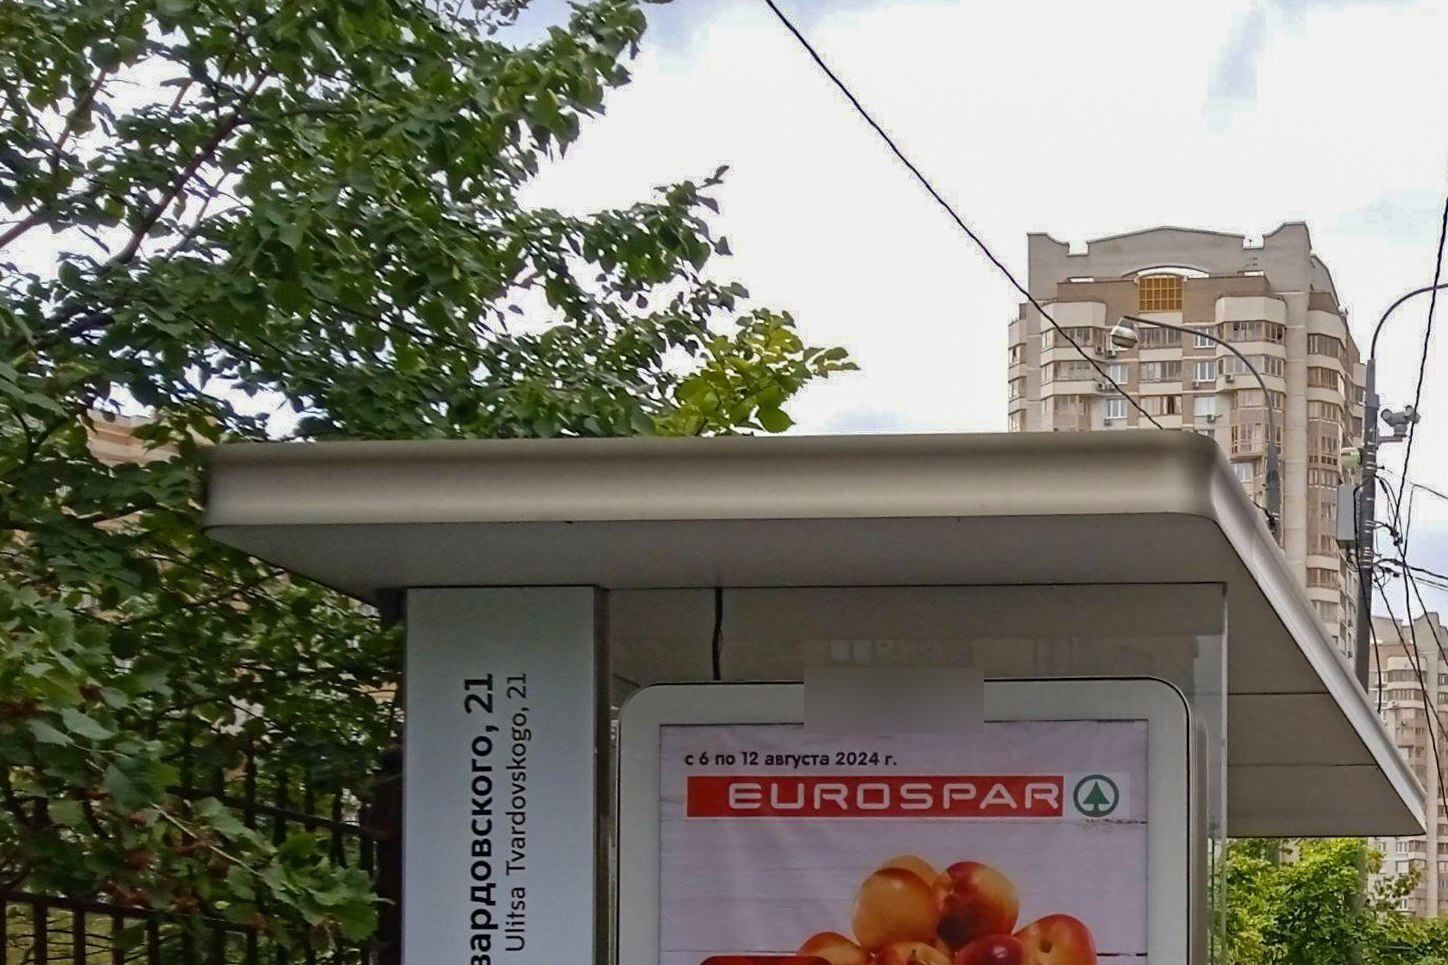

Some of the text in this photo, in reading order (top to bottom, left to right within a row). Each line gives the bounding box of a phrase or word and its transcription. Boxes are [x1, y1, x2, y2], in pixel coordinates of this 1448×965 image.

[464, 673, 494, 714] 21
[684, 751, 897, 769] с 6 по 12 августа 2024 г.
[505, 672, 531, 953] Ulitsa Tvardovskogo, 21
[728, 782, 1059, 810] EUROSPAR
